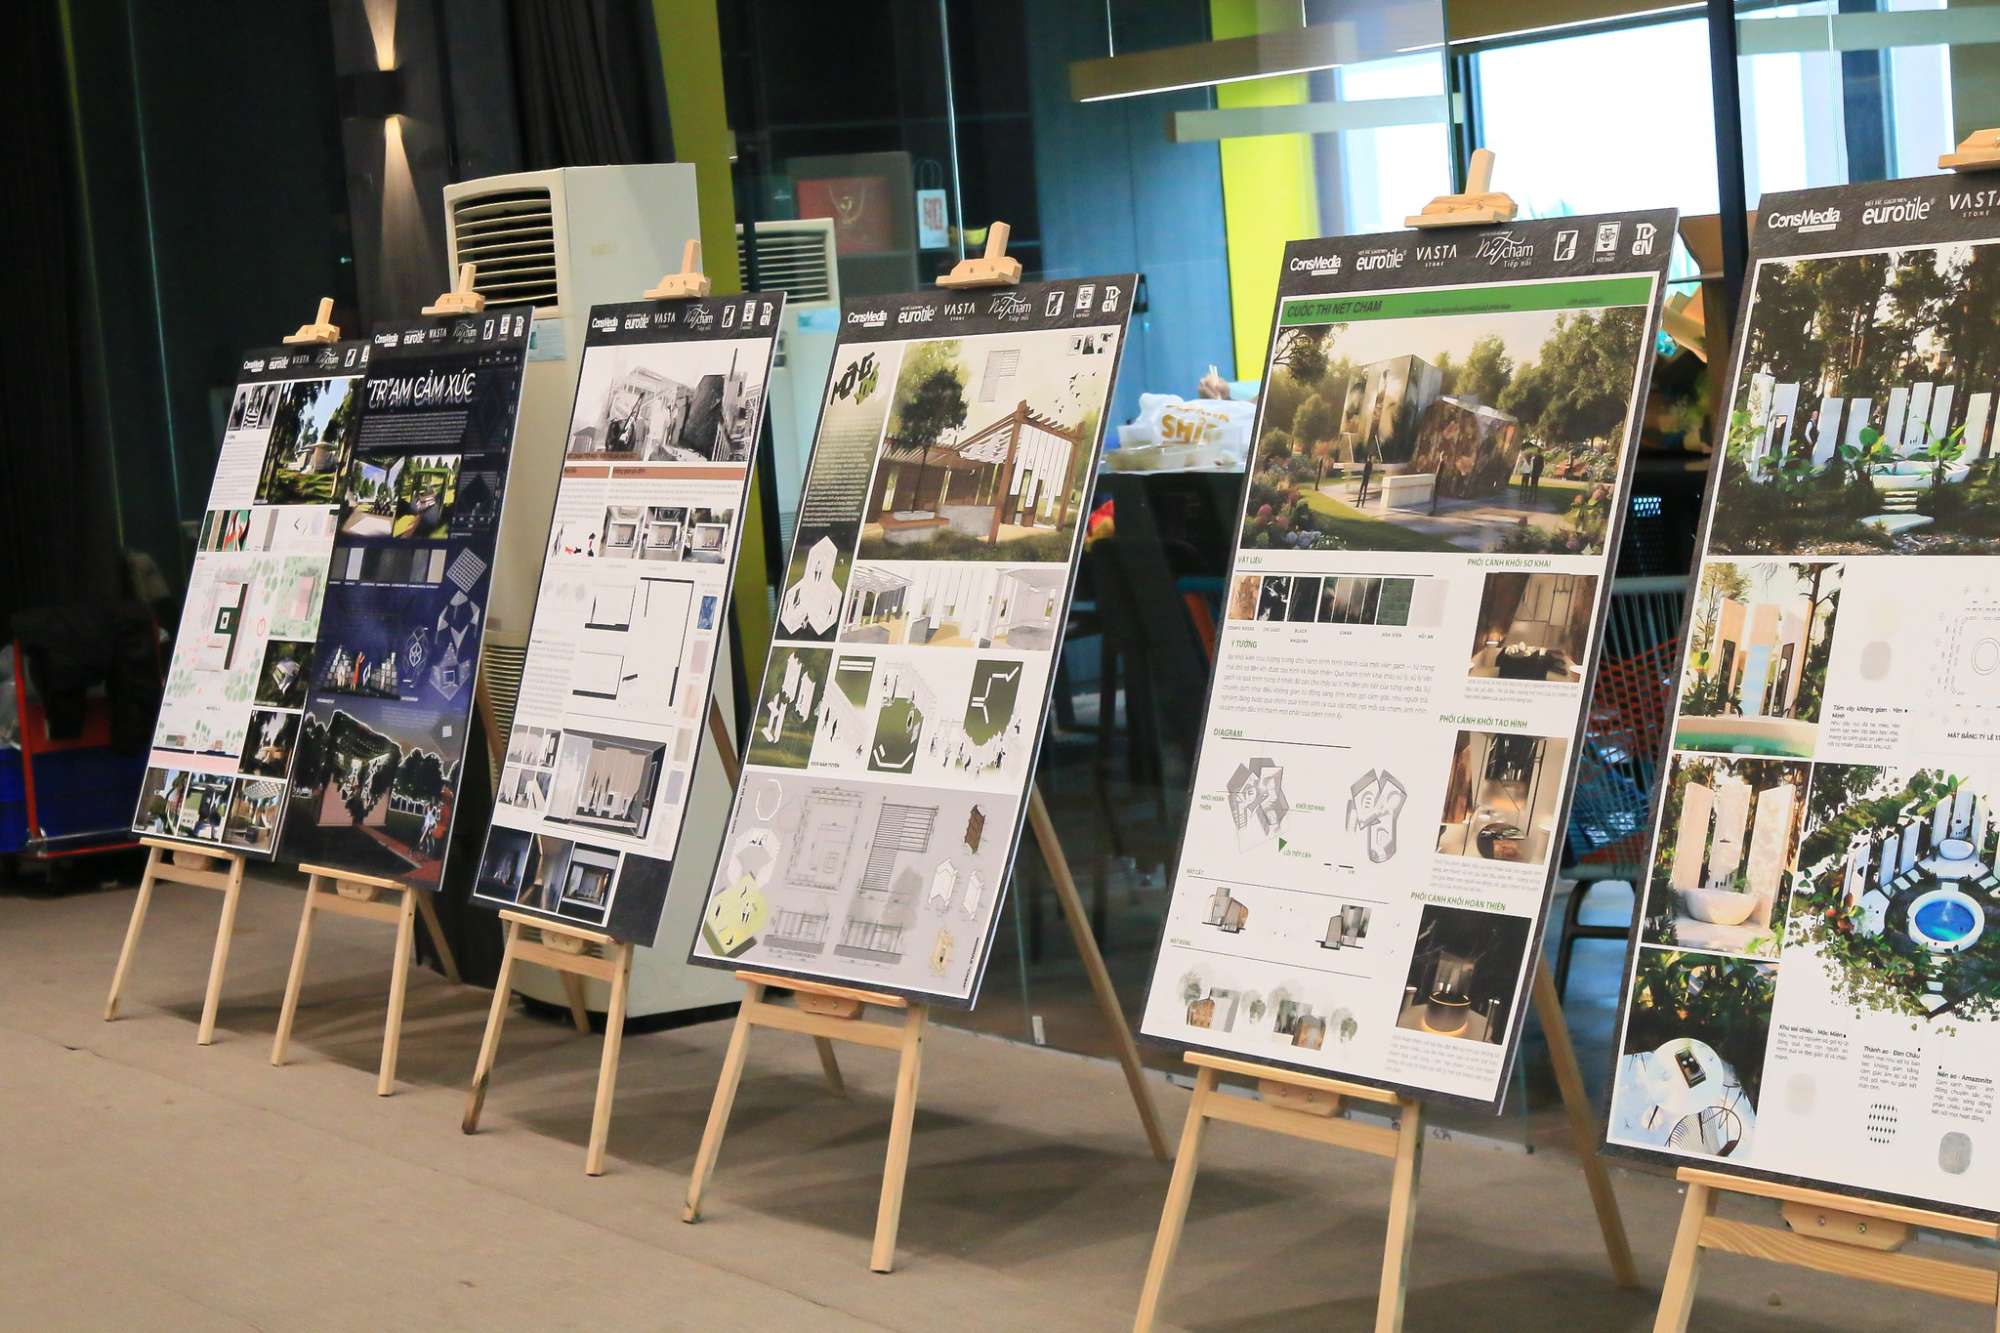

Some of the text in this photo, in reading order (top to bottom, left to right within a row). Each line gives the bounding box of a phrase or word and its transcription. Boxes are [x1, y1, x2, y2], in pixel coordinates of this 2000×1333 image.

[1768, 207, 1841, 229] ConsMedia
[1862, 196, 1930, 225] eurotile
[1290, 244, 1457, 272] ConsMedia eurotile VASTA
[654, 311, 676, 323] VASTA
[944, 302, 976, 315] VASTA
[445, 367, 476, 397] XÚC
